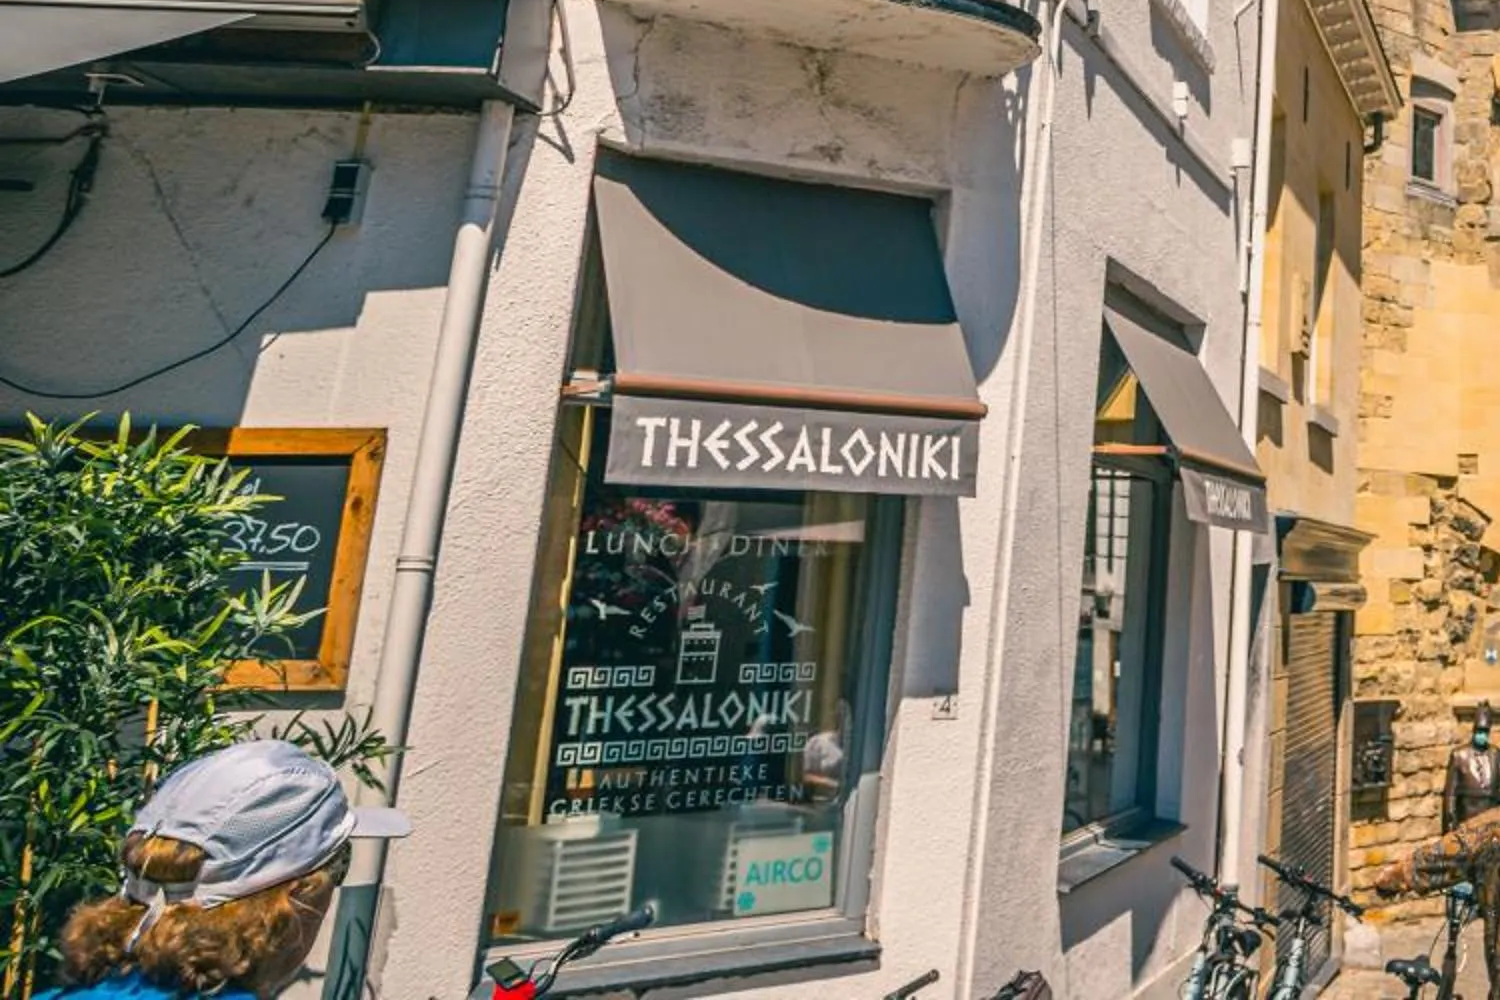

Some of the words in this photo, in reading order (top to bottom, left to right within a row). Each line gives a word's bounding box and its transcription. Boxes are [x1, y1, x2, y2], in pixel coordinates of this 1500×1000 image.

[635, 416, 961, 481] THESSALONIKI
[585, 530, 702, 556] LUNCH
[730, 535, 829, 557] DINER
[629, 578, 770, 640] RESTAURANT
[564, 689, 813, 737] THESSALONIKI
[600, 763, 769, 790] AUTHENTIEKE
[549, 794, 657, 817] GRIEKSE
[665, 783, 805, 810] GERECHTEN
[745, 856, 825, 886] AIRCO
